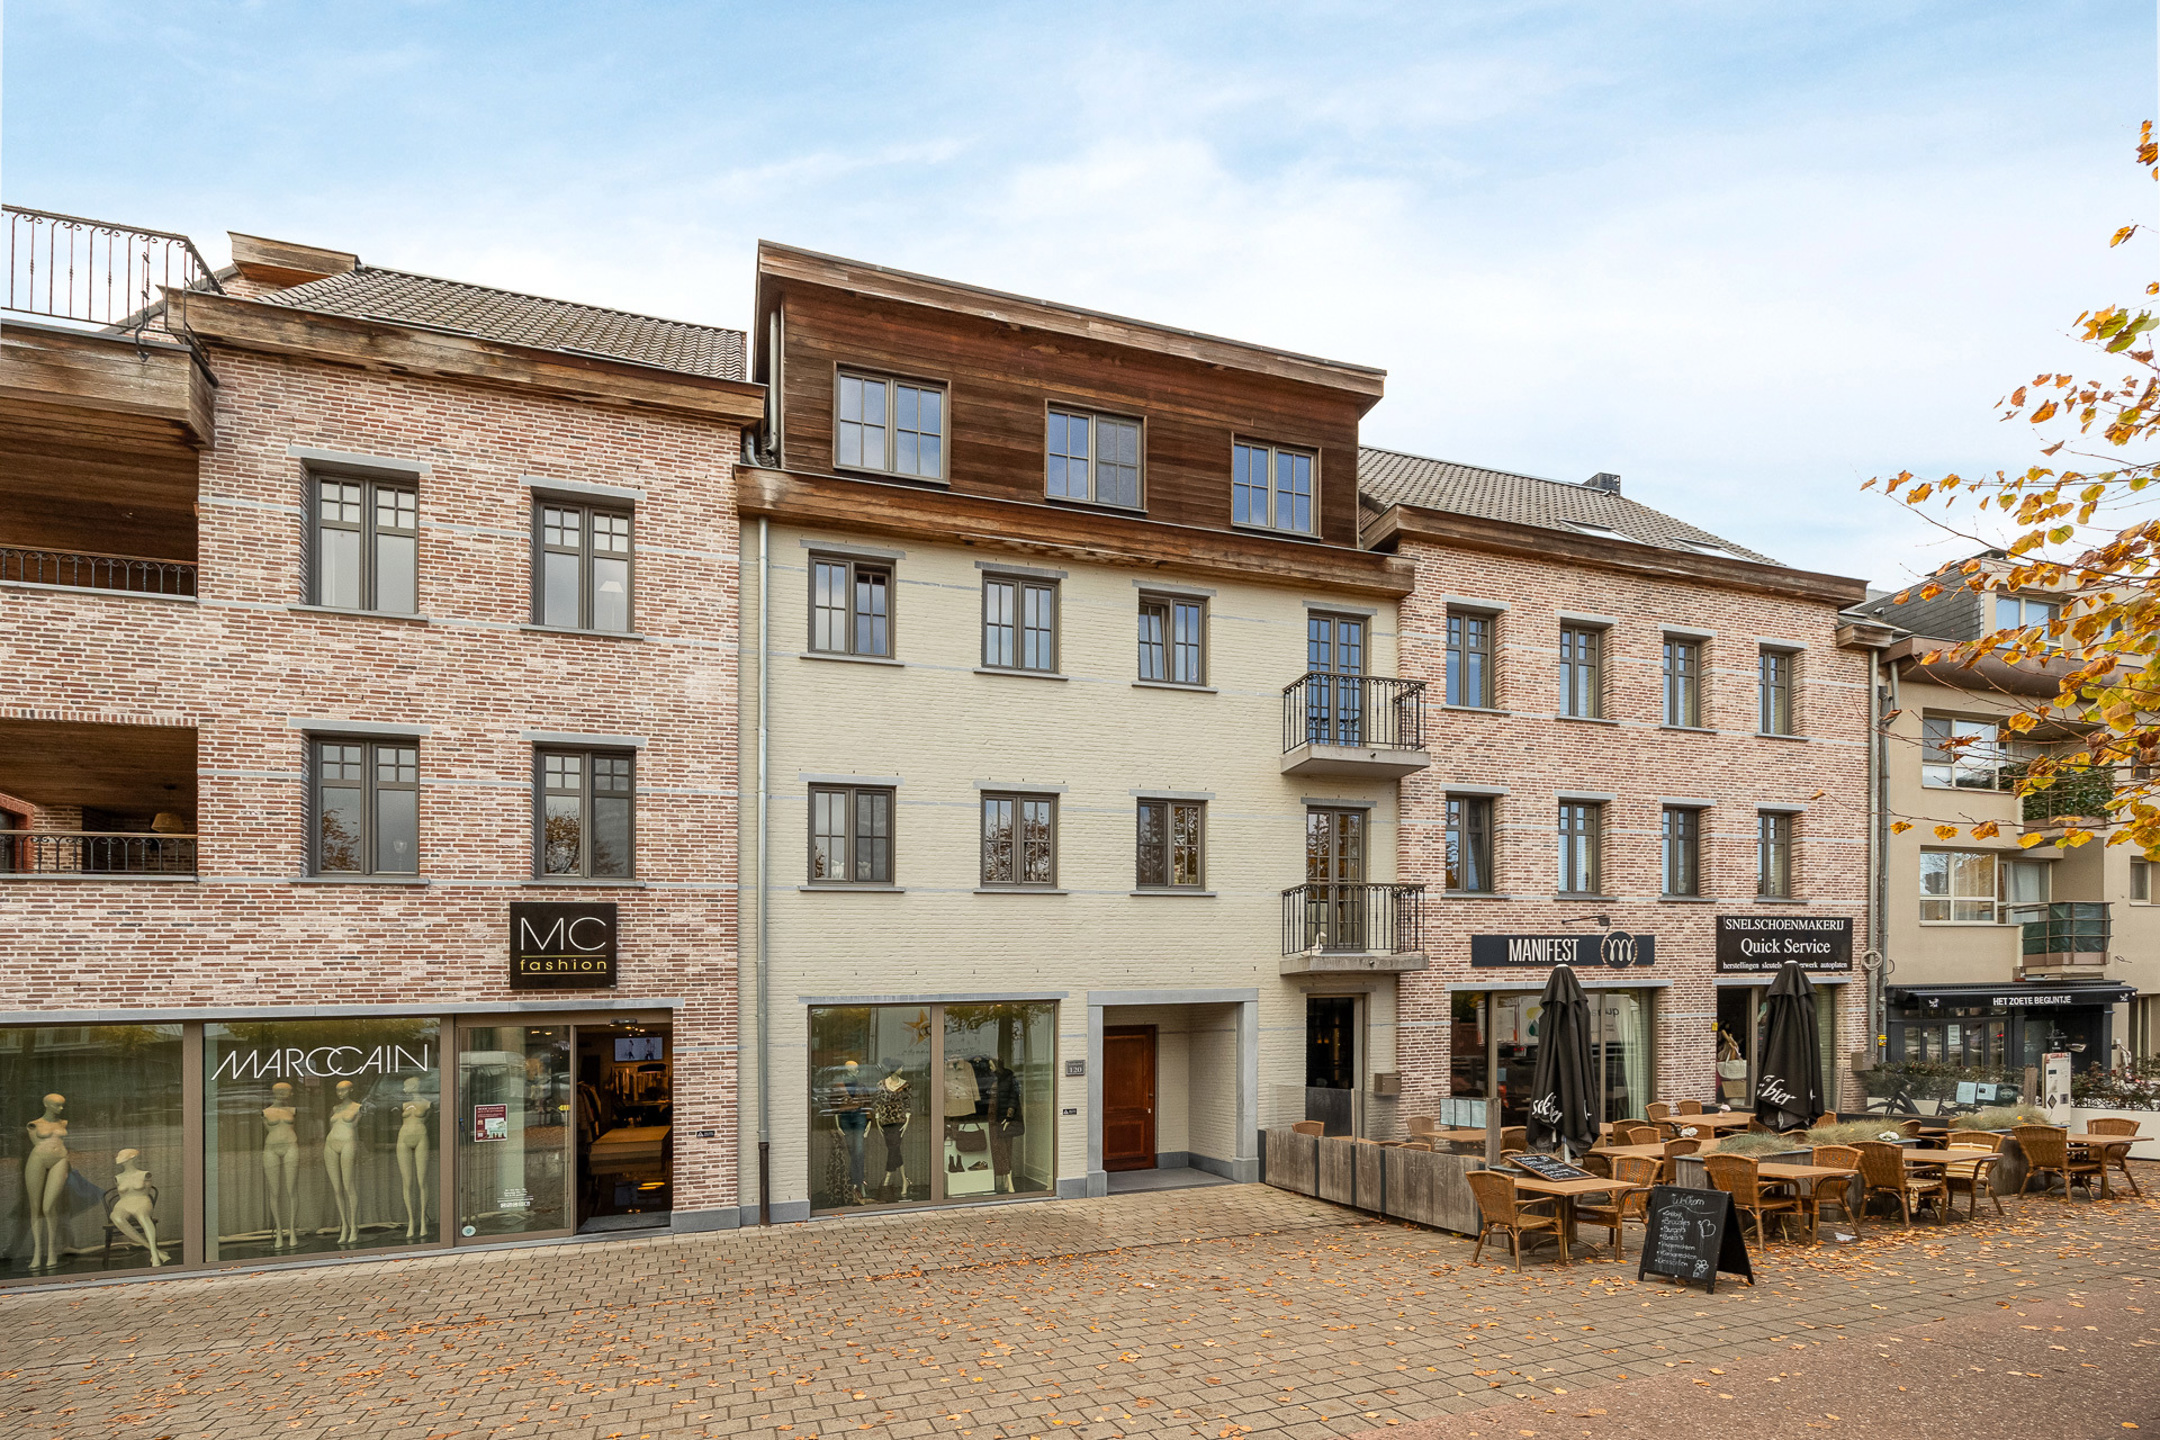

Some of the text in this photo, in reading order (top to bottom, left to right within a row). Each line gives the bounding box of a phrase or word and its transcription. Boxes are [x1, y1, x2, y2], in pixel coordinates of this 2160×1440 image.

[1725, 918, 1845, 931] SNELSCHOENMAKERIJ
[521, 916, 606, 951] MC
[1508, 938, 1580, 962] MANIFEST
[1740, 937, 1831, 956] Quick Service
[520, 959, 607, 971] fashion
[1722, 961, 1760, 971] herstellingen
[1993, 995, 2071, 1006] HET ZOETE BEGIJNTJE
